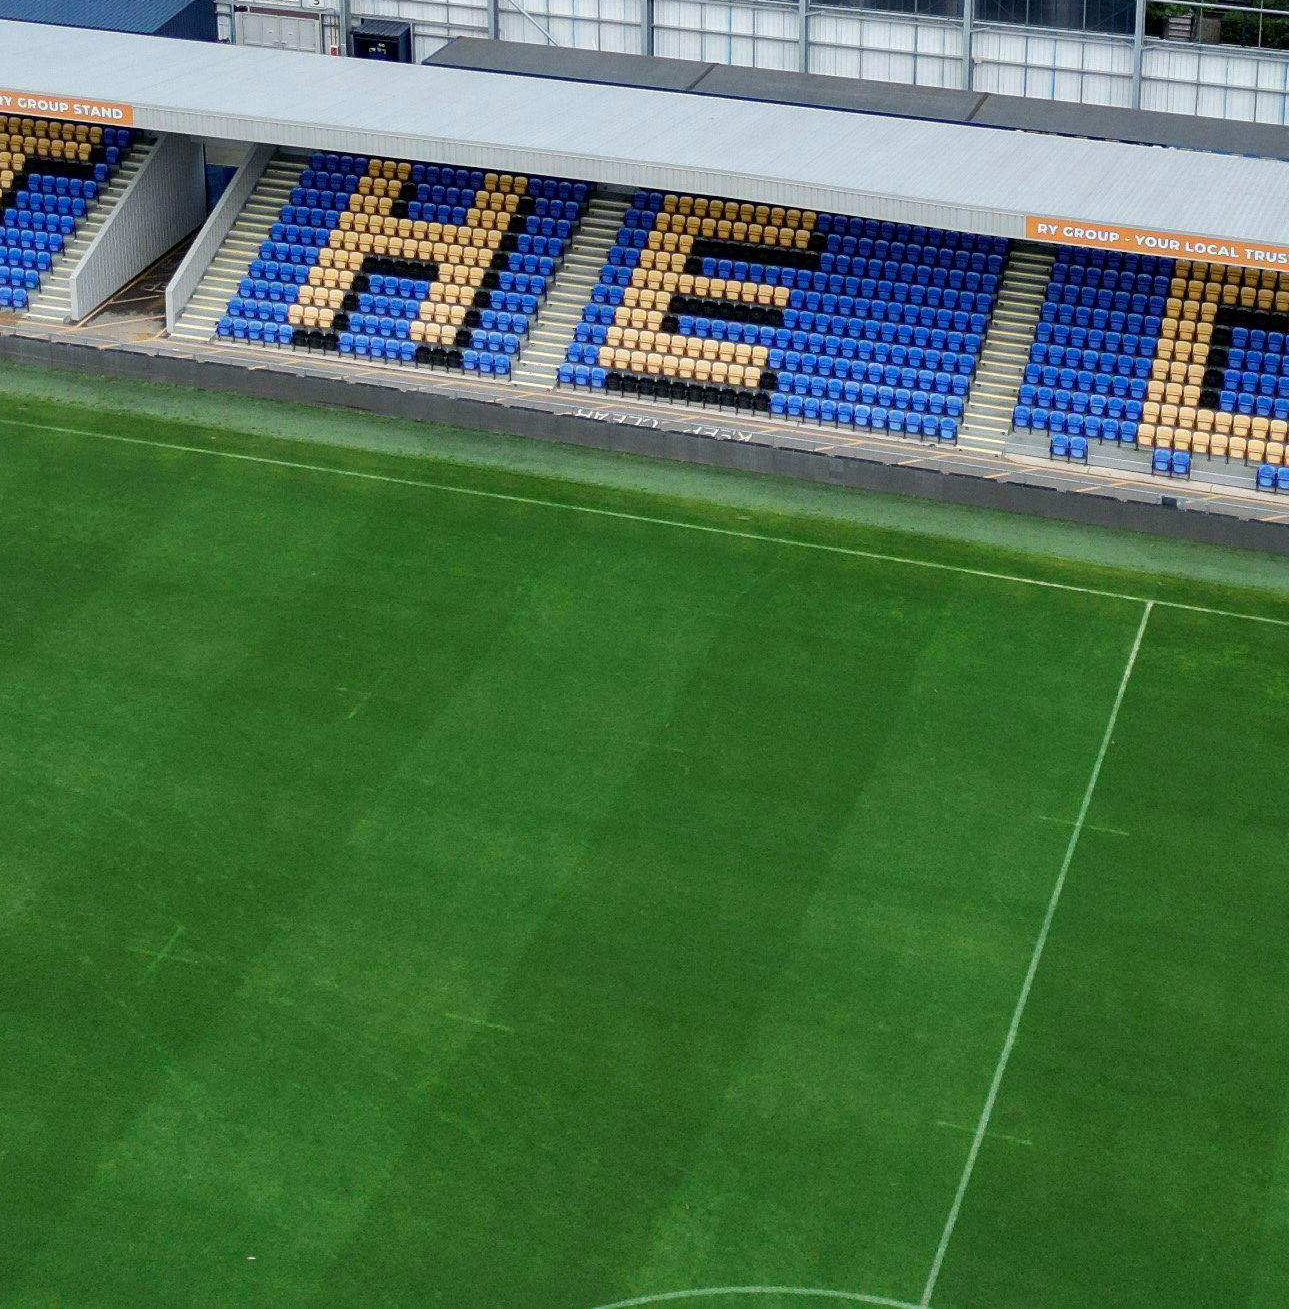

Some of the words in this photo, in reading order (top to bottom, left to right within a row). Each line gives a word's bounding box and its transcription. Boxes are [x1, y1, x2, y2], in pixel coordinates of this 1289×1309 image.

[17, 97, 69, 113] GROUP
[73, 103, 123, 120] STAND
[1037, 223, 1059, 236] RY
[1063, 226, 1121, 243] GROUP
[1135, 235, 1181, 251] YOUR
[1184, 241, 1240, 258] LOCAL
